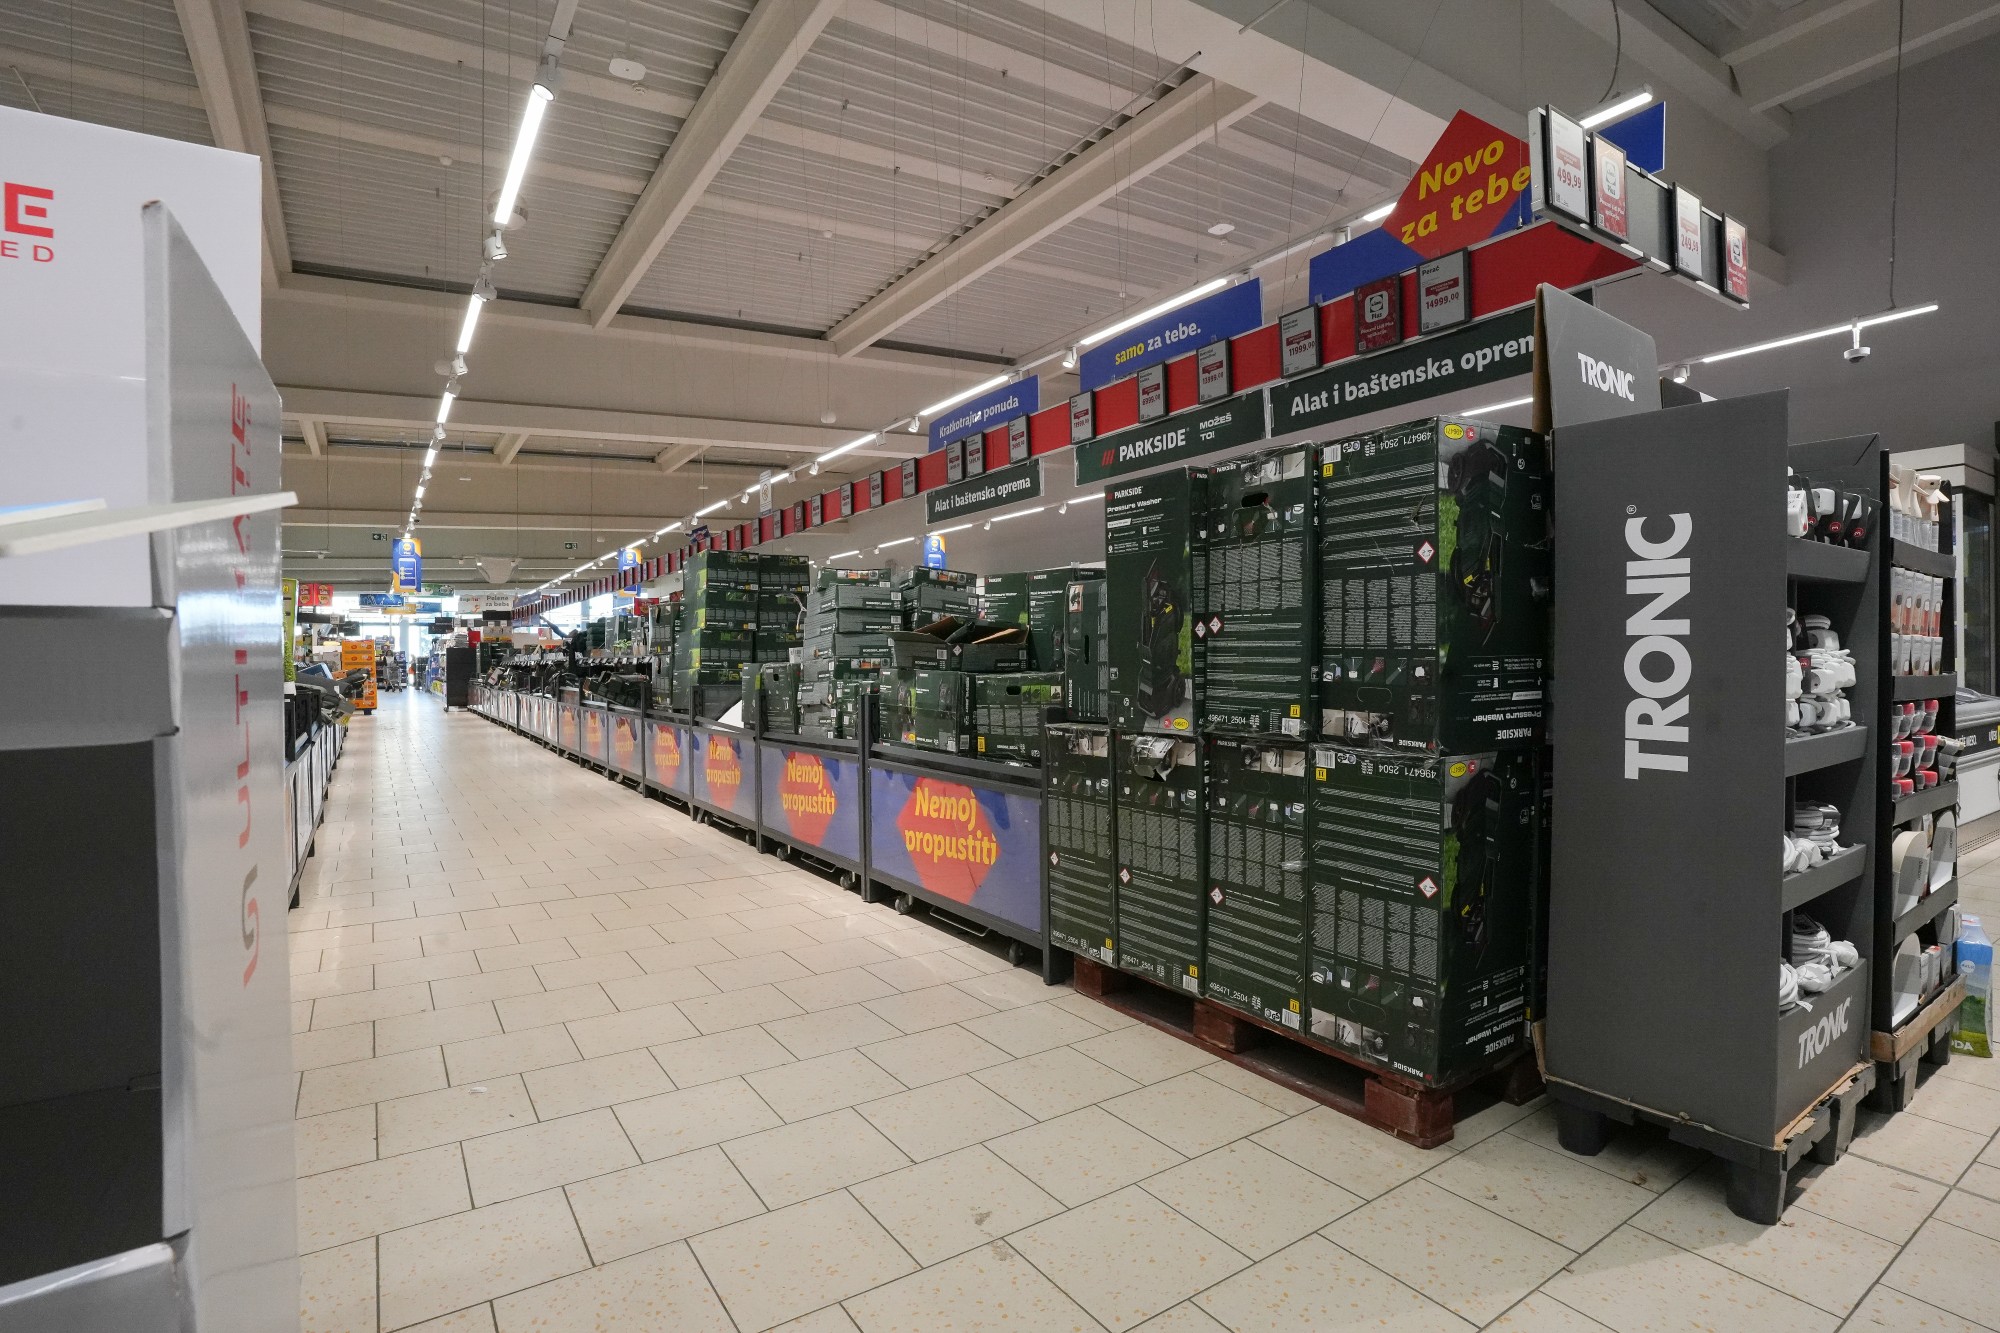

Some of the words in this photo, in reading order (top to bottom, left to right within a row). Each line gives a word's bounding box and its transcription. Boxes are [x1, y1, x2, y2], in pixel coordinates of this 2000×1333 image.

[1417, 139, 1505, 201] Novo
[1401, 211, 1439, 246] za
[1450, 165, 1531, 222] tebe
[1115, 342, 1145, 366] samo
[1147, 337, 1162, 352] za
[1164, 321, 1201, 346] tebe.
[1291, 390, 1329, 417] Alat
[1333, 383, 1339, 405] i
[1344, 356, 1455, 403] baštenska
[1461, 333, 1535, 373] oprem
[1577, 352, 1635, 403] TRONIC
[939, 410, 983, 439] Kratkotrajna
[983, 396, 1020, 421] ponuda
[1199, 411, 1232, 430] MOŽEŠ
[1119, 428, 1186, 462] PARKSIDE
[1200, 431, 1215, 441] TO!
[934, 498, 950, 513] Alat
[950, 496, 955, 508] i
[955, 484, 996, 507] baštenska
[997, 476, 1031, 498] oprema
[1114, 486, 1142, 500] PARKSIDE
[1624, 512, 1693, 780] TRONIC
[1472, 713, 1505, 722] Washer
[1497, 728, 1532, 740] PARKSIDE
[709, 740, 733, 764] Nemoj
[1399, 739, 1427, 749] PARKSIDE
[787, 758, 823, 790] Nemoj
[782, 789, 836, 817] propustiti
[914, 786, 977, 832] Nemoj
[904, 829, 997, 866] propustiti
[1209, 982, 1248, 1003] 496471_2504
[1798, 1005, 1850, 1070] TRONIC
[1393, 1061, 1424, 1078] PARKSIDE
